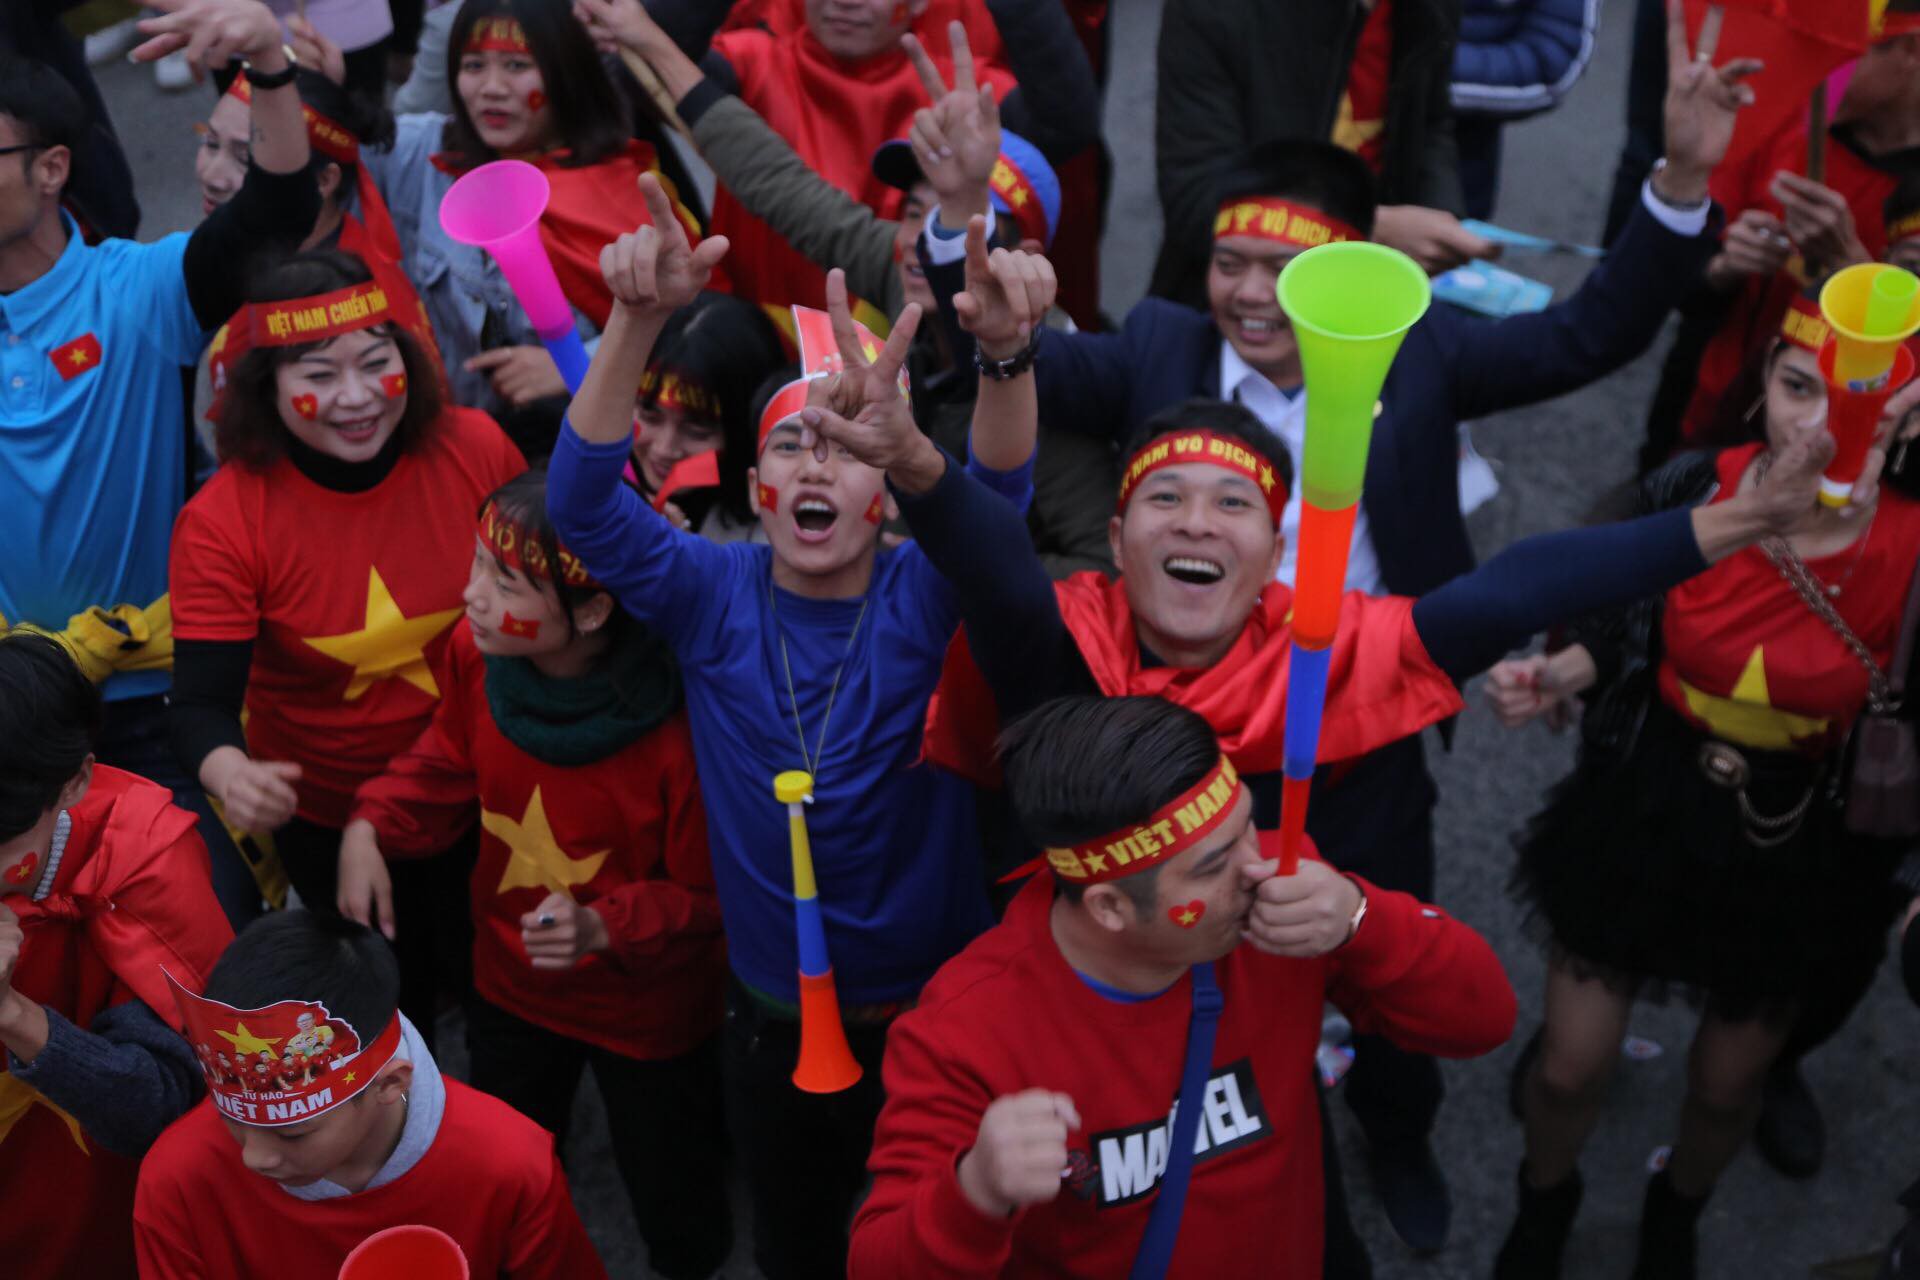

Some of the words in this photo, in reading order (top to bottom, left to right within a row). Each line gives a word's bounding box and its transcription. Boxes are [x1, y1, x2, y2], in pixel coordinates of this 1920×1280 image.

[291, 306, 329, 332] NAM
[1131, 442, 1170, 479] NAM
[1174, 434, 1203, 453] VÔ
[1105, 819, 1175, 866] VIỆT
[1173, 773, 1232, 834] NAM
[213, 1088, 257, 1119] VIỆT
[267, 1087, 333, 1121] NAM
